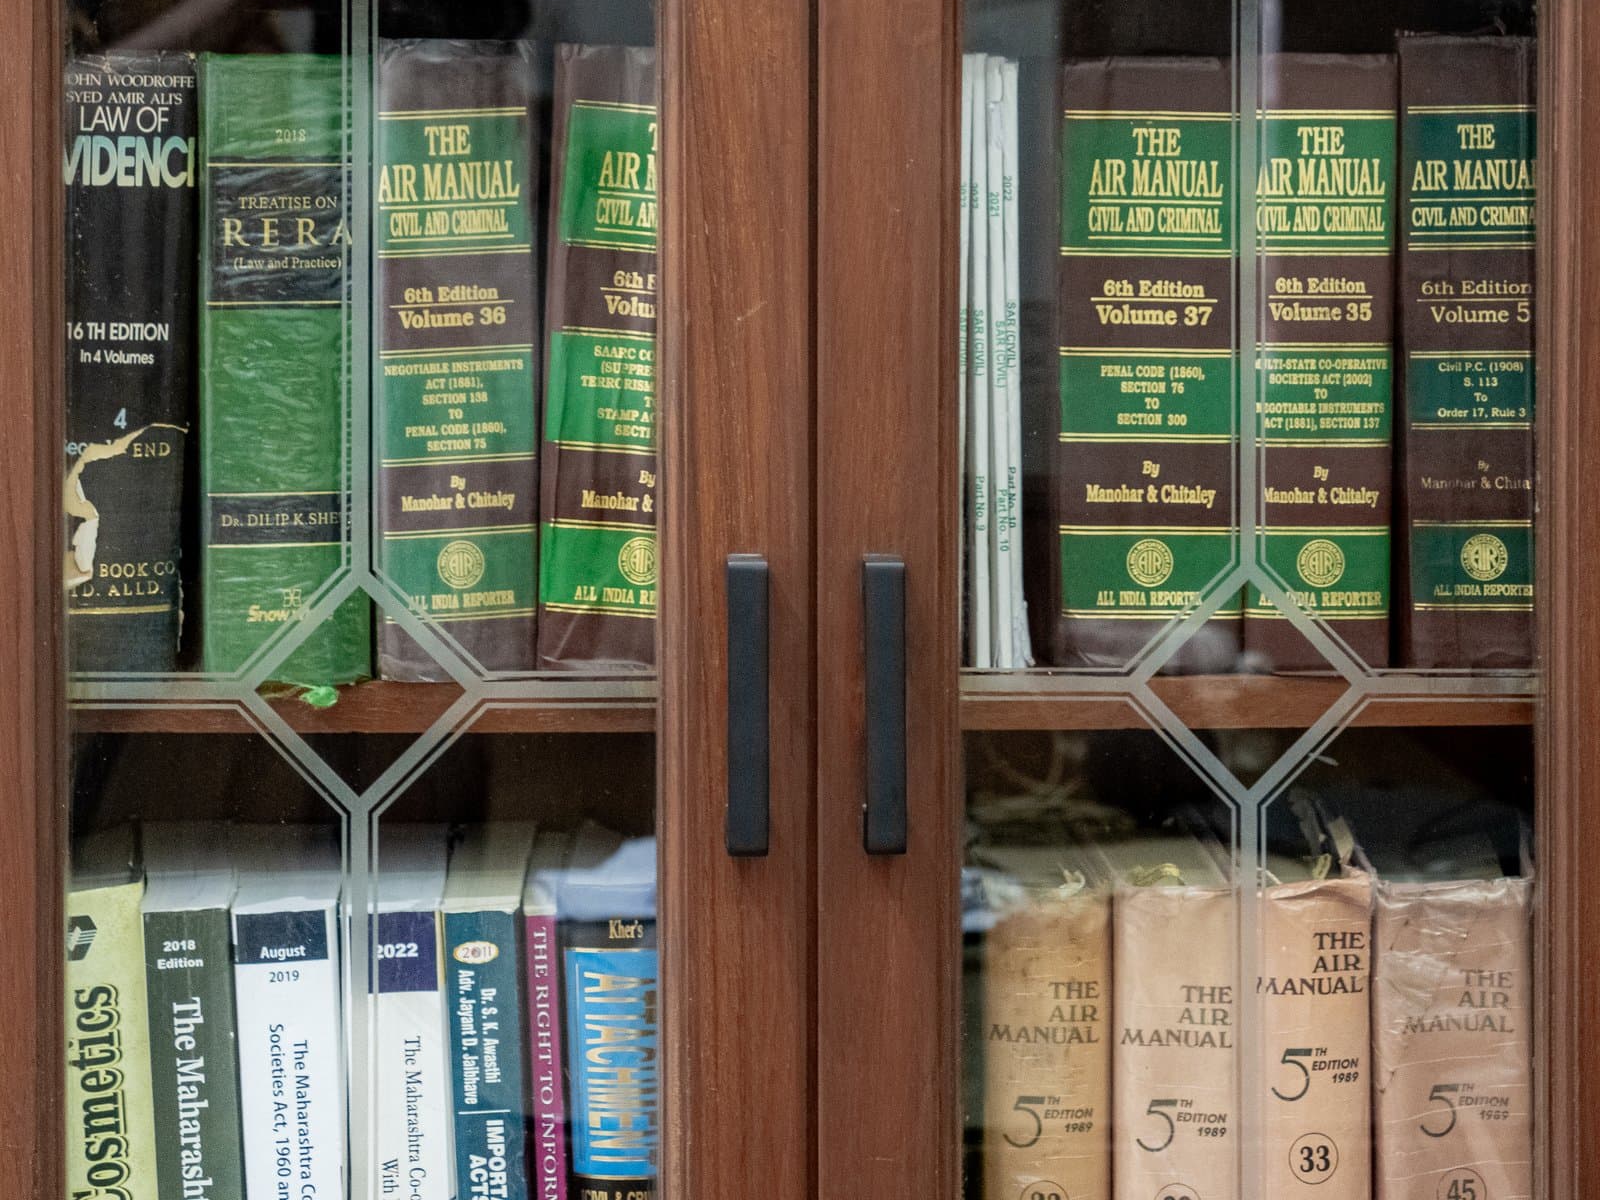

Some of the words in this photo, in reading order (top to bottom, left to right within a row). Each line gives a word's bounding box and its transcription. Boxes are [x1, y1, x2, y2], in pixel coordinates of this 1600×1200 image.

[80, 106, 131, 132] LAW
[136, 106, 169, 132] OF
[425, 125, 471, 157] THE
[1133, 128, 1181, 157] THE
[1297, 126, 1345, 156] THE
[1457, 123, 1496, 150] THE
[379, 163, 420, 203] AIR
[422, 160, 520, 201] MANUAL
[598, 150, 641, 191] AIR
[1089, 159, 1127, 197] AIR
[1131, 159, 1223, 198] MANUAL
[1256, 158, 1294, 196] AIR
[1297, 158, 1386, 197] MANUAL
[1411, 160, 1449, 191] AIR
[238, 196, 310, 210] TREATISE
[315, 196, 337, 209] ON
[595, 197, 634, 226] CIVIL
[389, 212, 422, 238] CIVIL
[424, 211, 449, 236] AND
[452, 208, 509, 235] CRIMINAL
[1088, 206, 1123, 233] CIVIL
[1126, 206, 1155, 233] AND
[1157, 206, 1223, 234] CRIMINAL
[1293, 205, 1320, 232] AND
[1323, 205, 1385, 233] CRIMINAL
[1411, 206, 1446, 228] CIVIL
[1449, 206, 1478, 227] AND
[222, 217, 353, 248] RERA
[234, 256, 263, 270] (Law
[267, 256, 288, 269] and
[291, 256, 343, 270] Practice)
[614, 270, 644, 290] 6th
[1103, 279, 1134, 297] 6th
[1139, 280, 1205, 298] Edition
[1275, 277, 1303, 294] 6th
[1307, 276, 1366, 294] Edition
[1421, 280, 1454, 296] 6th
[1461, 280, 1532, 296] Edition
[404, 286, 432, 304] 6th
[438, 285, 499, 303] Edition
[398, 308, 474, 329] Volume
[480, 306, 507, 326] 36
[974, 309, 984, 334] SAR
[1007, 302, 1017, 327] SAR
[1096, 304, 1178, 326] Volume
[1184, 305, 1213, 327] 37
[1268, 302, 1342, 322] Volume
[1346, 302, 1373, 322] 35
[1430, 305, 1509, 324] Volume
[1516, 301, 1532, 324] 5
[66, 321, 84, 341] 16
[86, 322, 105, 341] TH
[109, 321, 169, 341] EDITION
[80, 349, 92, 364] In
[104, 348, 154, 365] Volumes
[1474, 392, 1488, 402] To
[113, 408, 128, 429] 4
[1437, 408, 1470, 418] Order
[1491, 408, 1516, 418] Rule
[132, 442, 171, 458] END
[1142, 461, 1160, 478] By
[450, 476, 466, 491] By
[582, 489, 639, 512] Manohar
[997, 488, 1008, 515] Part
[1086, 484, 1144, 503] Manohar
[1160, 485, 1217, 508] Chitaley
[1330, 487, 1380, 508] Chitaley
[247, 513, 290, 527] DILIP
[100, 562, 148, 578] BOOK
[108, 581, 165, 597] ALLD.
[463, 590, 516, 609] REPORTER
[1321, 591, 1383, 607] REPORTER
[609, 920, 644, 941] Kher's
[1313, 931, 1365, 951] THE
[163, 940, 196, 952] 2018
[260, 945, 306, 961] August
[533, 926, 548, 979] THE
[157, 957, 204, 970] Edition
[1312, 953, 1364, 974] AIR
[268, 970, 300, 984] 2019
[1048, 980, 1100, 1000] THE
[1180, 984, 1232, 1004] THE
[172, 996, 205, 1052] The
[459, 999, 477, 1036] Jayant
[1048, 1004, 1100, 1022] AIR
[1176, 1006, 1232, 1026] AIR
[535, 983, 553, 1067] RIGHT
[988, 1023, 1100, 1044] MANUAL
[1402, 1014, 1515, 1035] MANUAL
[1120, 1027, 1232, 1049] MANUAL
[269, 1023, 285, 1098] Societies
[293, 1039, 309, 1071] The
[404, 1035, 421, 1067] The
[483, 1038, 501, 1084] Awasthi
[583, 970, 657, 1165] ATTACHMENT
[1311, 1058, 1359, 1071] EDITION
[539, 1070, 554, 1105] TO
[272, 1102, 290, 1133] Act,
[405, 1070, 425, 1162] Maharashtra
[1044, 1107, 1094, 1121] EDITION
[1176, 1111, 1228, 1124] EDITION
[295, 1075, 314, 1180] Maharashtra
[276, 1137, 292, 1177] 1960
[1299, 1144, 1331, 1173] 33
[382, 1157, 400, 1194] With
